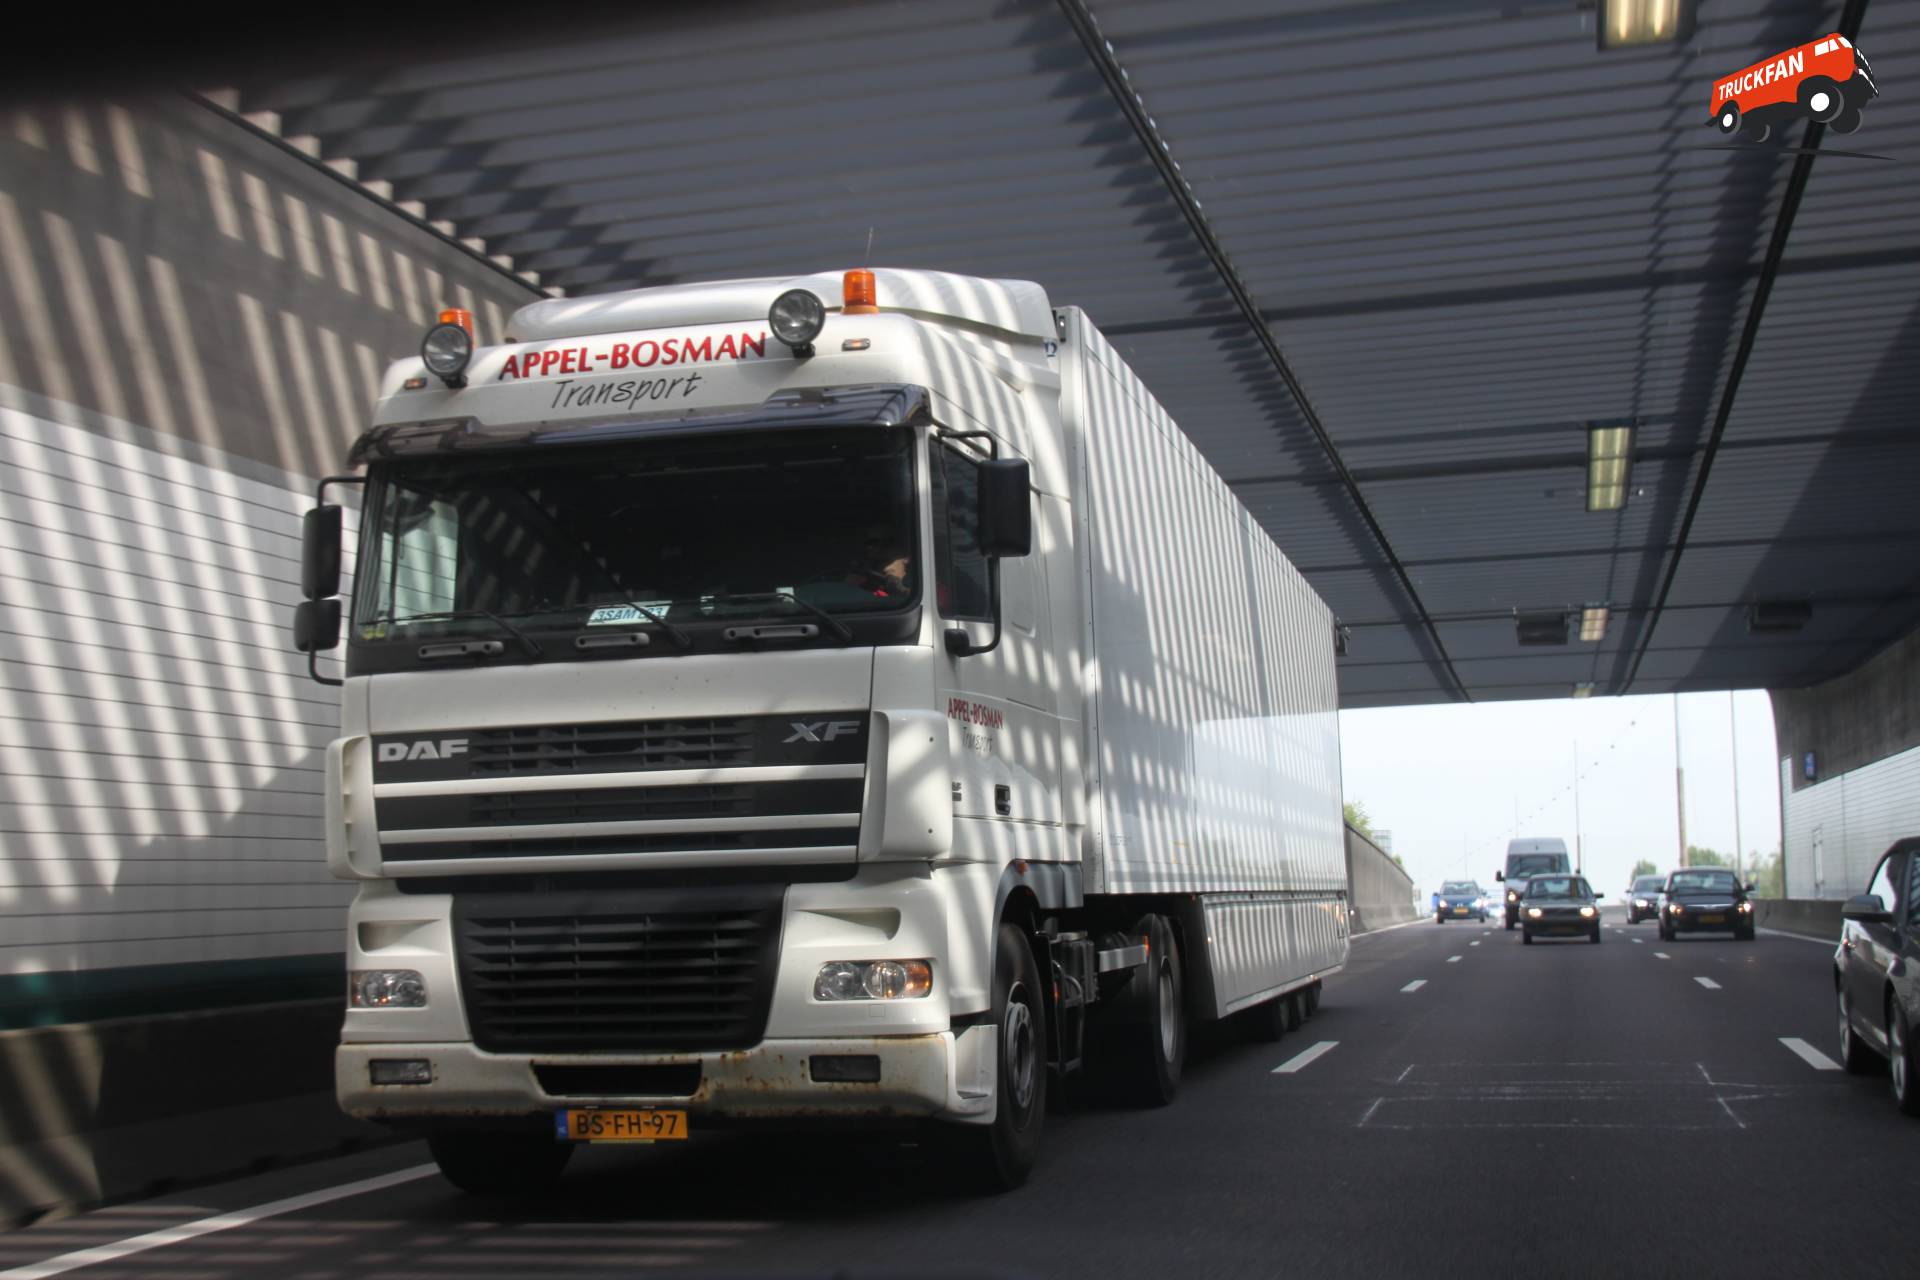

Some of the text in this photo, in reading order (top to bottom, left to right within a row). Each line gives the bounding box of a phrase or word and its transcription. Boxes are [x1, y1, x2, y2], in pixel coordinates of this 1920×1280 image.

[498, 332, 767, 380] APPEL-BOSMAN
[552, 372, 703, 410] Transport
[947, 697, 1004, 729] APPEL-BOSMAN
[782, 721, 861, 743] XF
[378, 739, 469, 762] DAF
[576, 1114, 679, 1135] BS-FH-97
